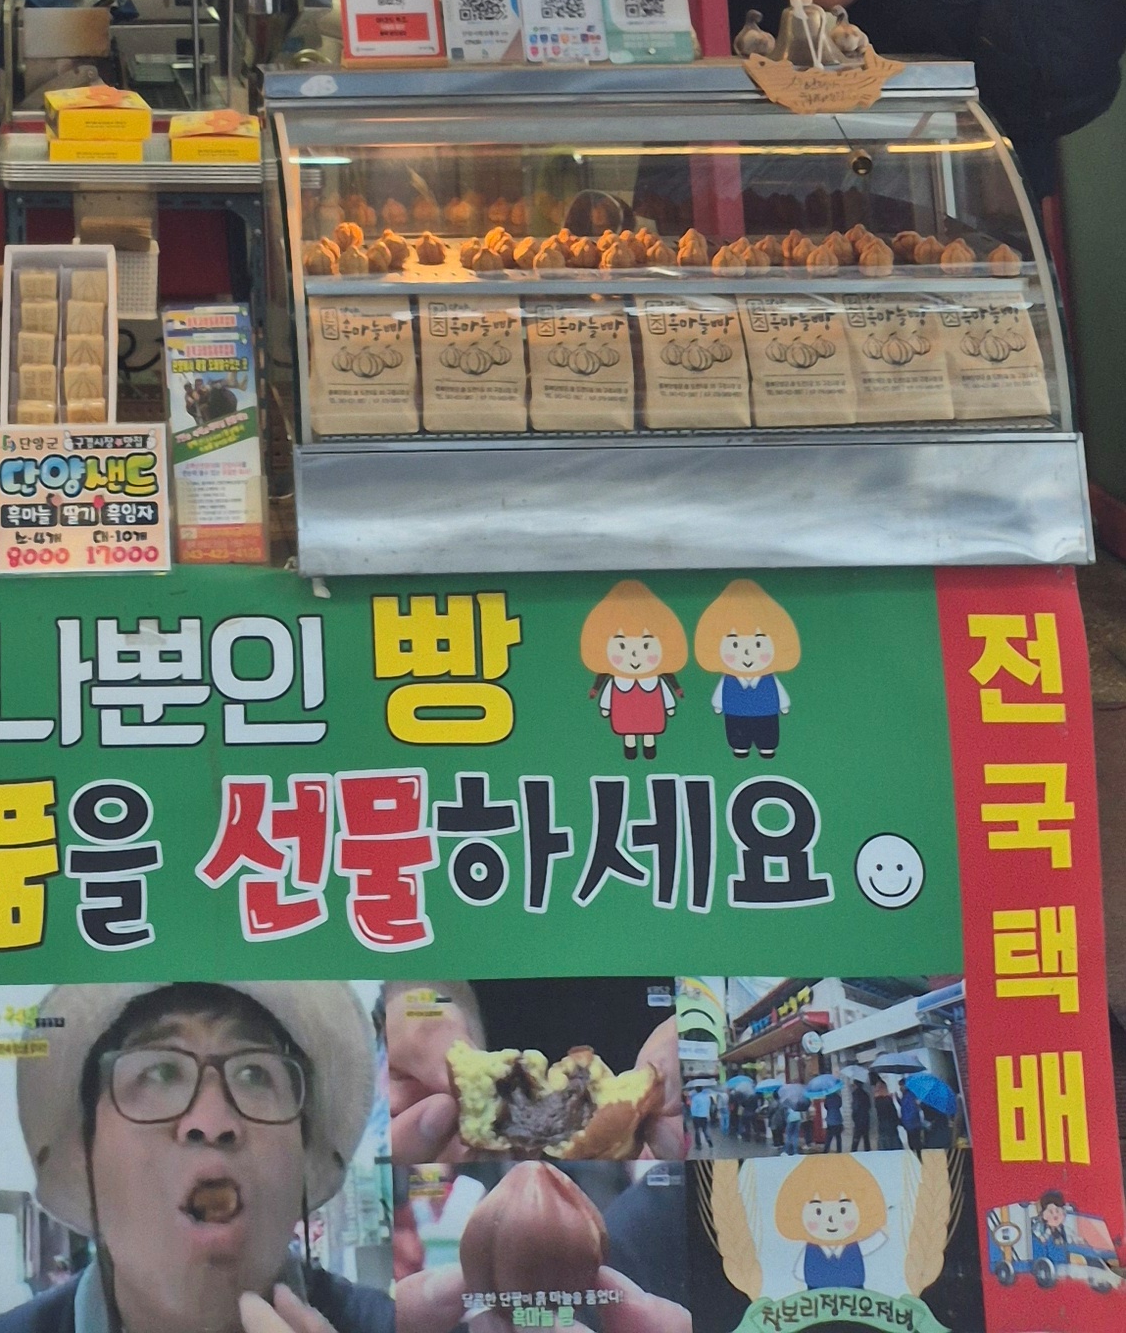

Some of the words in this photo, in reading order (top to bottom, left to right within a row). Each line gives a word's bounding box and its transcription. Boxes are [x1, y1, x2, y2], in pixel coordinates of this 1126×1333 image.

[0, 451, 160, 497] 단양샌드
[19, 436, 58, 451] 단양군
[74, 436, 114, 449] 구경시장
[122, 435, 144, 448] 맛집
[7, 505, 52, 526] 흑마늘
[62, 504, 97, 525] 딸기
[106, 502, 155, 524] 흑임자
[370, 590, 524, 745] 빵
[196, 766, 835, 953] 선물하세요
[966, 611, 1092, 1165] 전국택배
